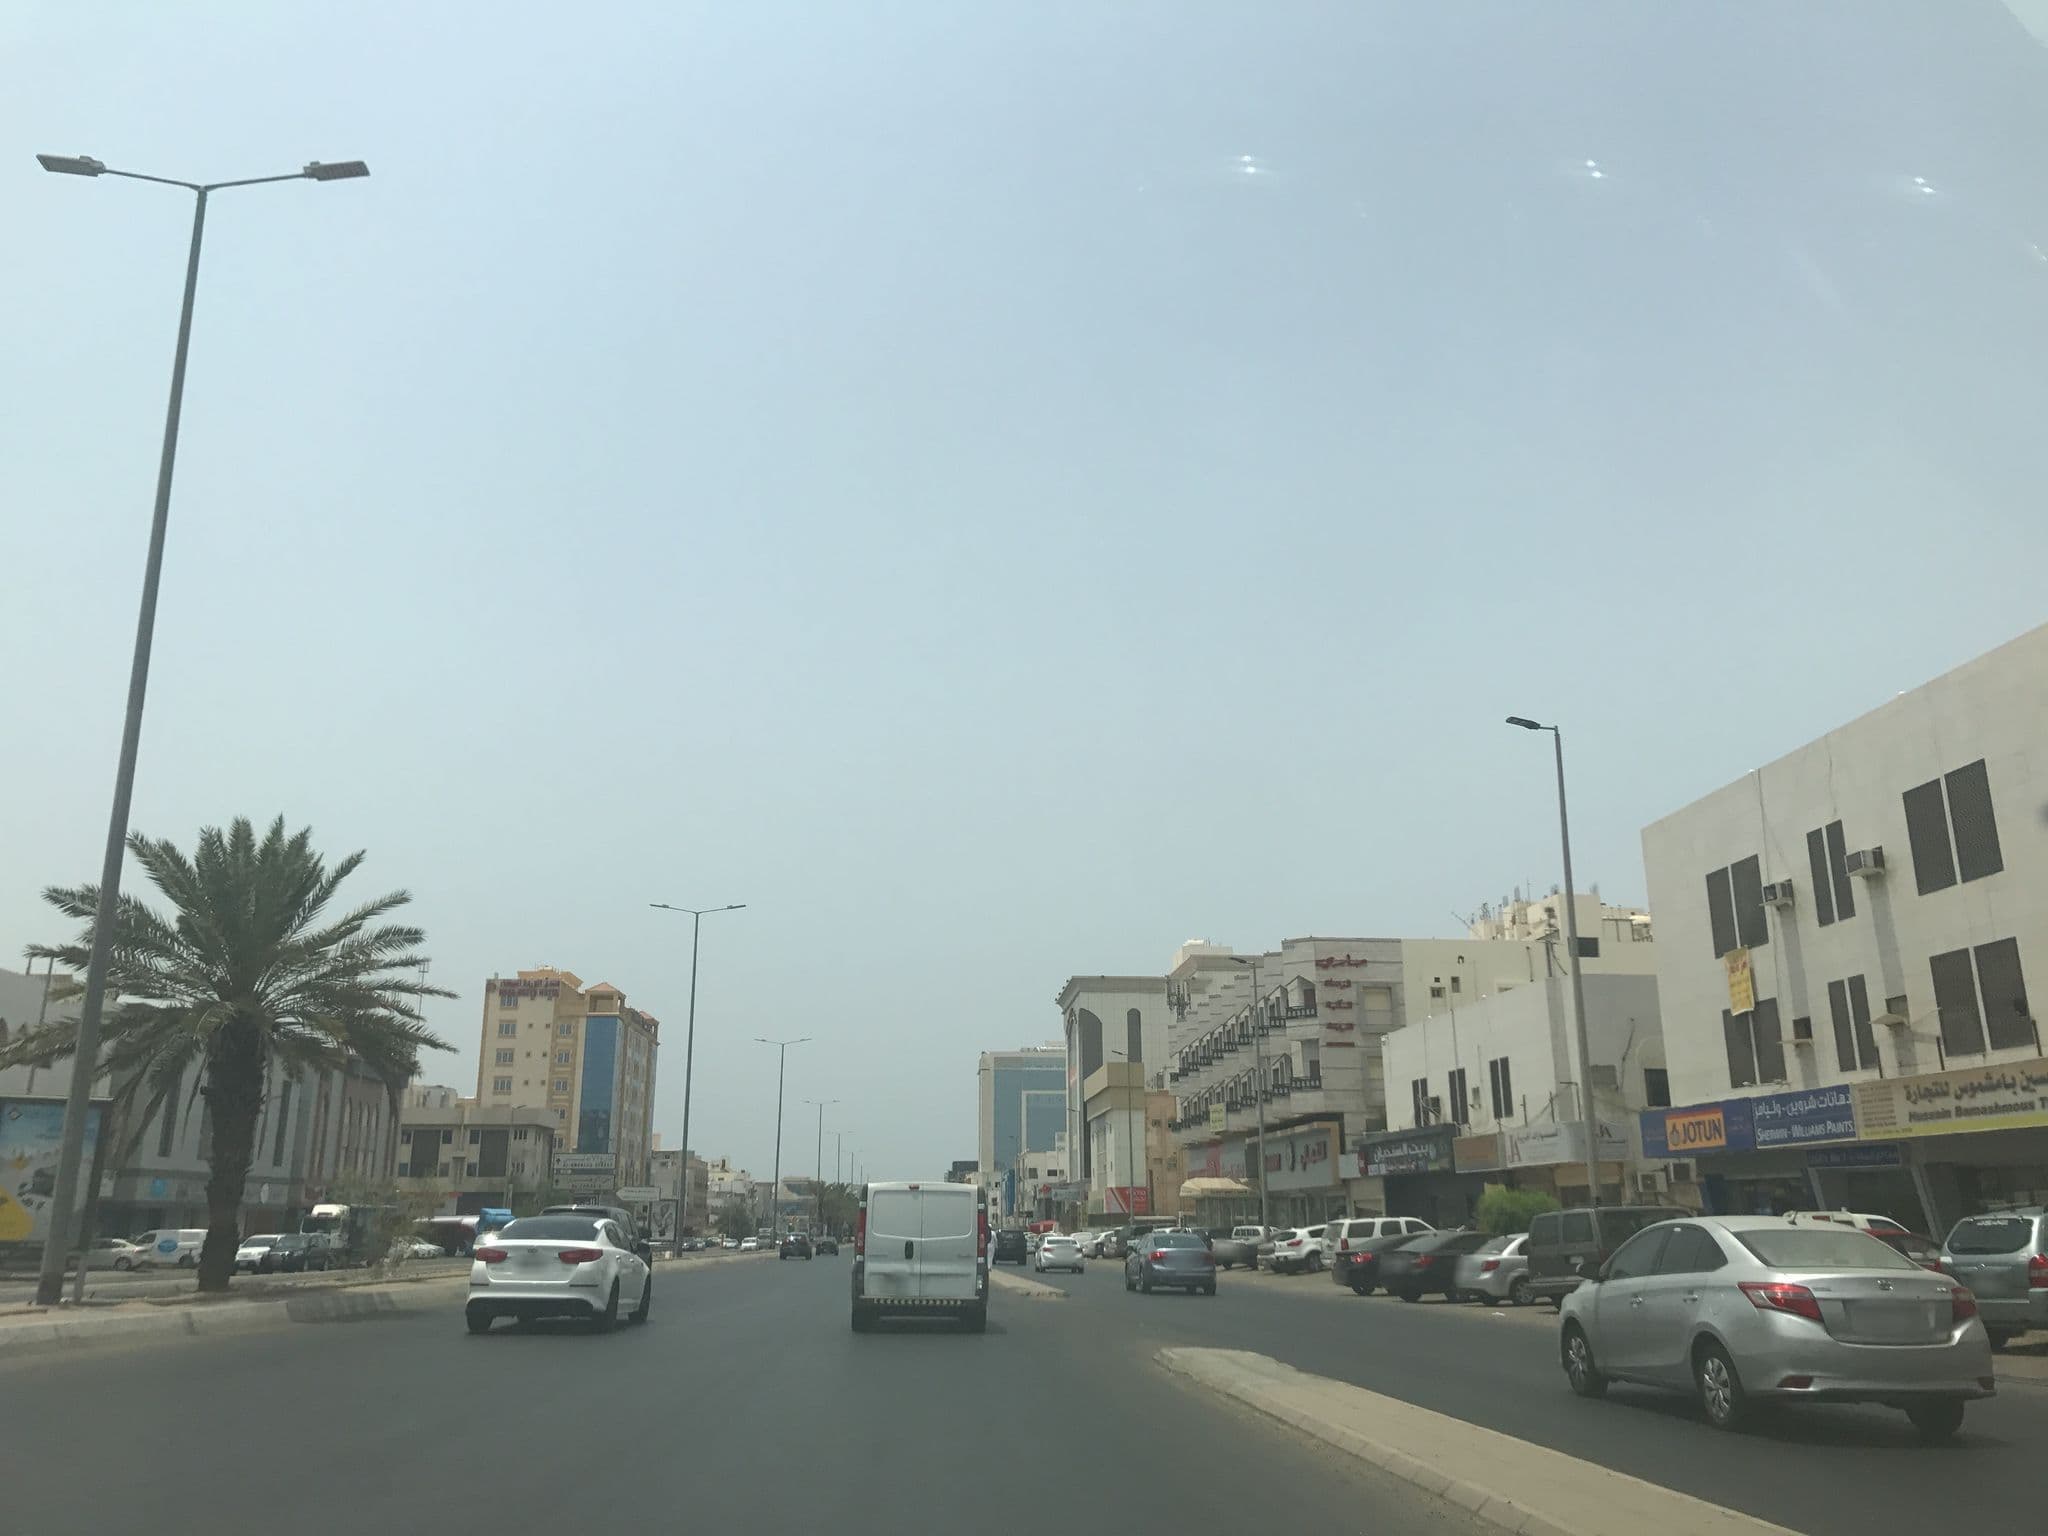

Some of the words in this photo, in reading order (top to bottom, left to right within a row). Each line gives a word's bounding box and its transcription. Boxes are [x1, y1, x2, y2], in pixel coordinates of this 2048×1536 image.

[1817, 1090, 1853, 1109] دهانات
[1903, 1080, 1950, 1105] للتجارة
[1786, 1095, 1818, 1117] شروين
[1682, 1117, 1722, 1144] JOTUN
[1826, 1119, 1854, 1134] PAINTS
